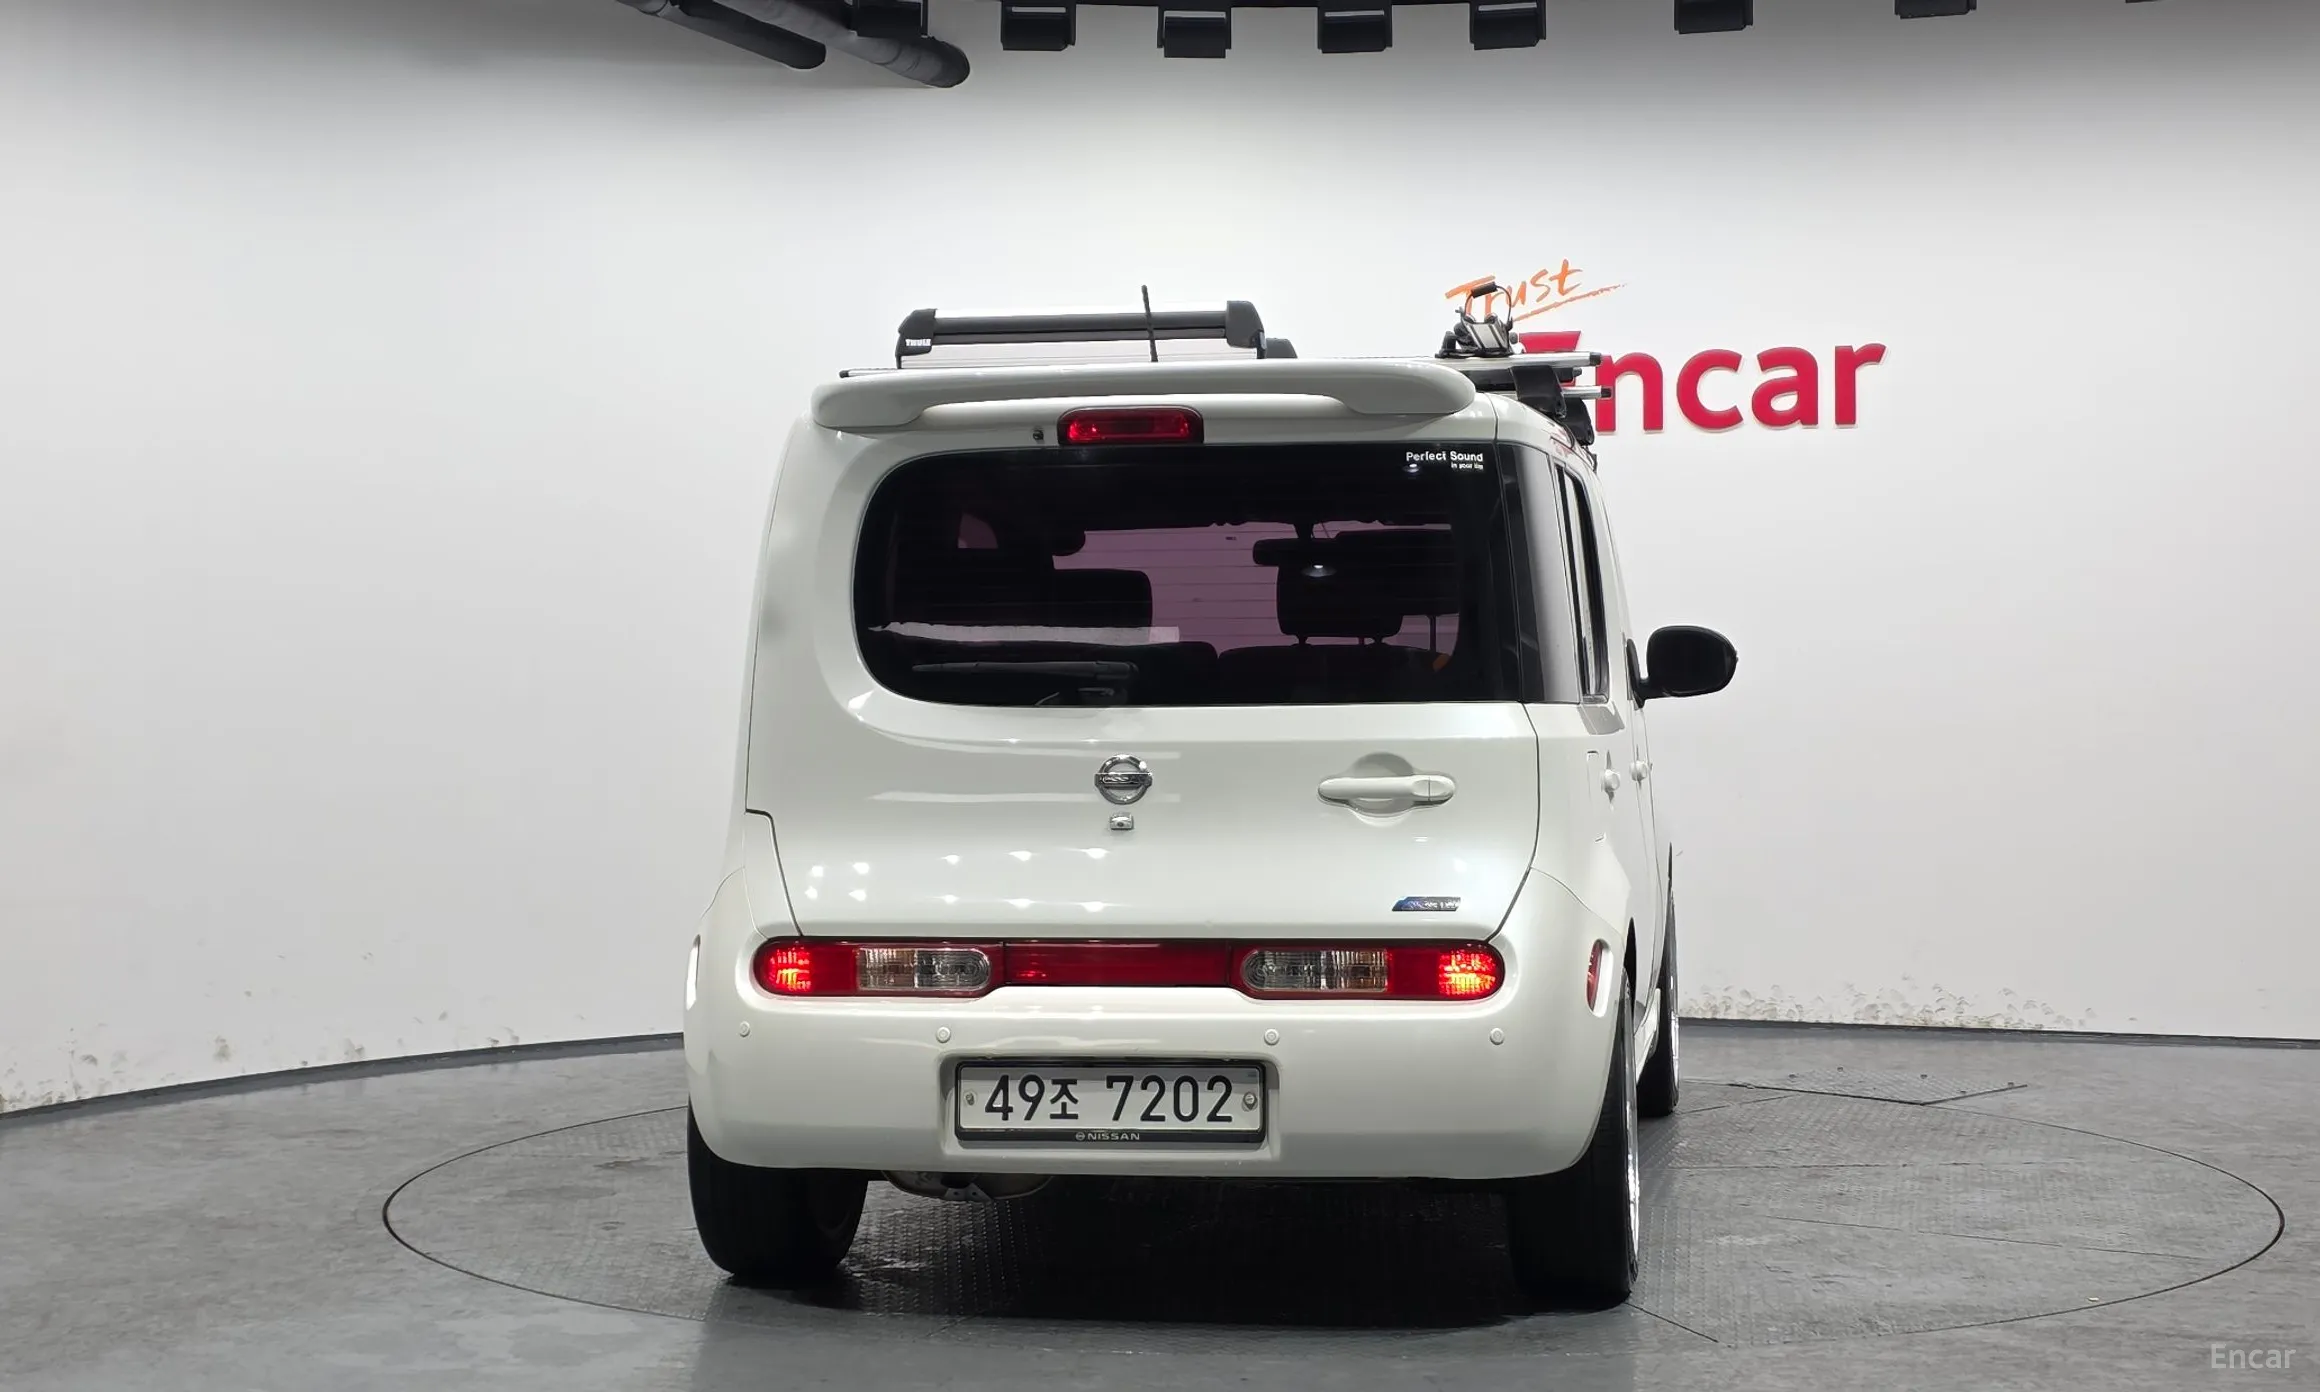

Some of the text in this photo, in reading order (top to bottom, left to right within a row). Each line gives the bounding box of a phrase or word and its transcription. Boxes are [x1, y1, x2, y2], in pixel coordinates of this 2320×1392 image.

[1445, 259, 1583, 319] Trust
[1406, 451, 1483, 462] Perfect Sound
[984, 1074, 1233, 1122] 49조 7202
[1087, 1131, 1140, 1141] NISSAN
